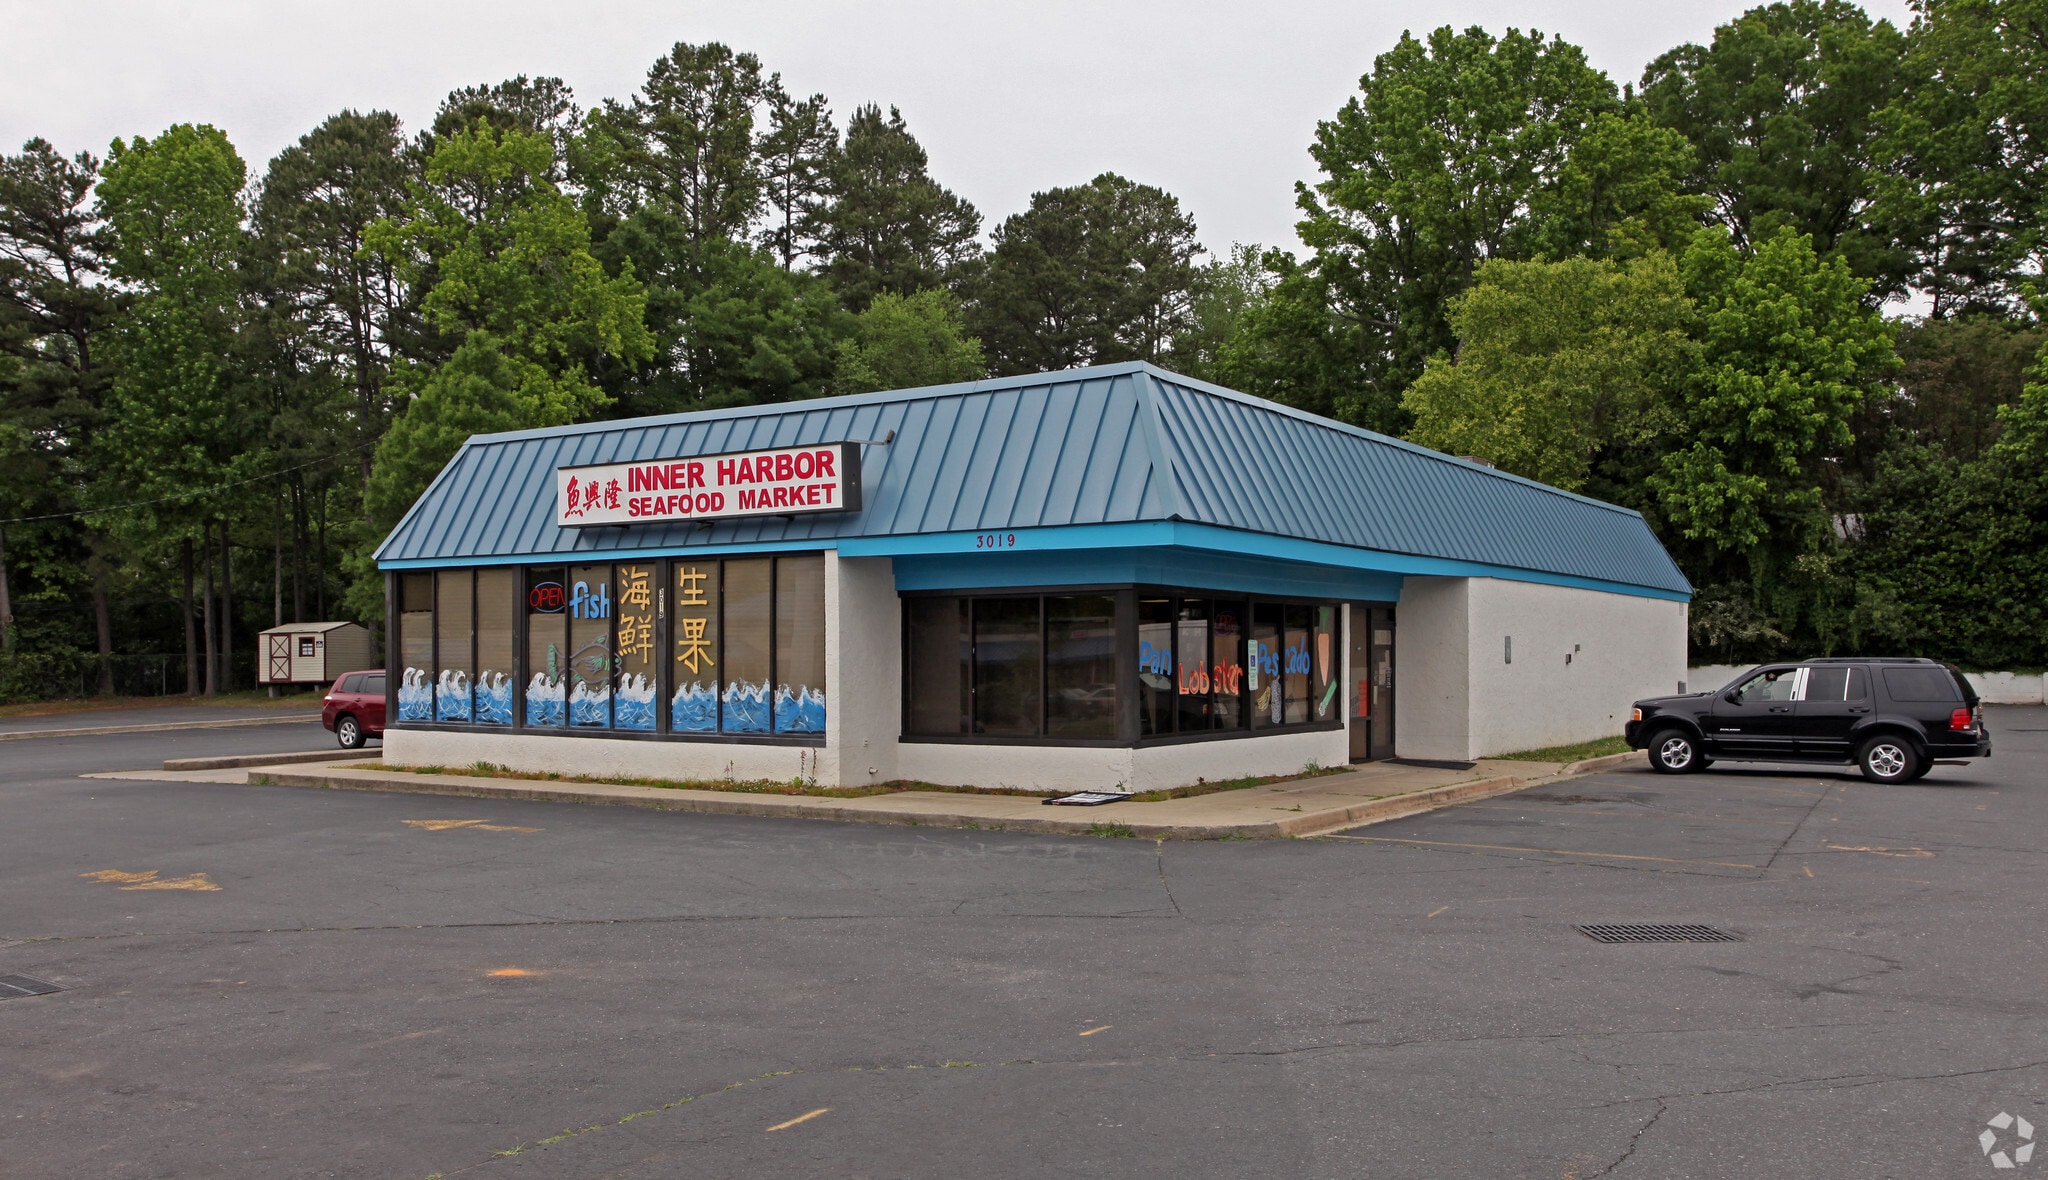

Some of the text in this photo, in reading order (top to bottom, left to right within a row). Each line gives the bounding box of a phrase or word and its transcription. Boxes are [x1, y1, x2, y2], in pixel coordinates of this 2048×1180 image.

[628, 450, 836, 493] INNER HARBOR
[564, 475, 623, 519] 魚興隆
[628, 483, 837, 518] SEAFOOD MARKET
[976, 533, 1015, 549] 3019
[529, 587, 566, 608] OPEN
[569, 580, 611, 619] fish
[1139, 640, 1172, 676] Pan
